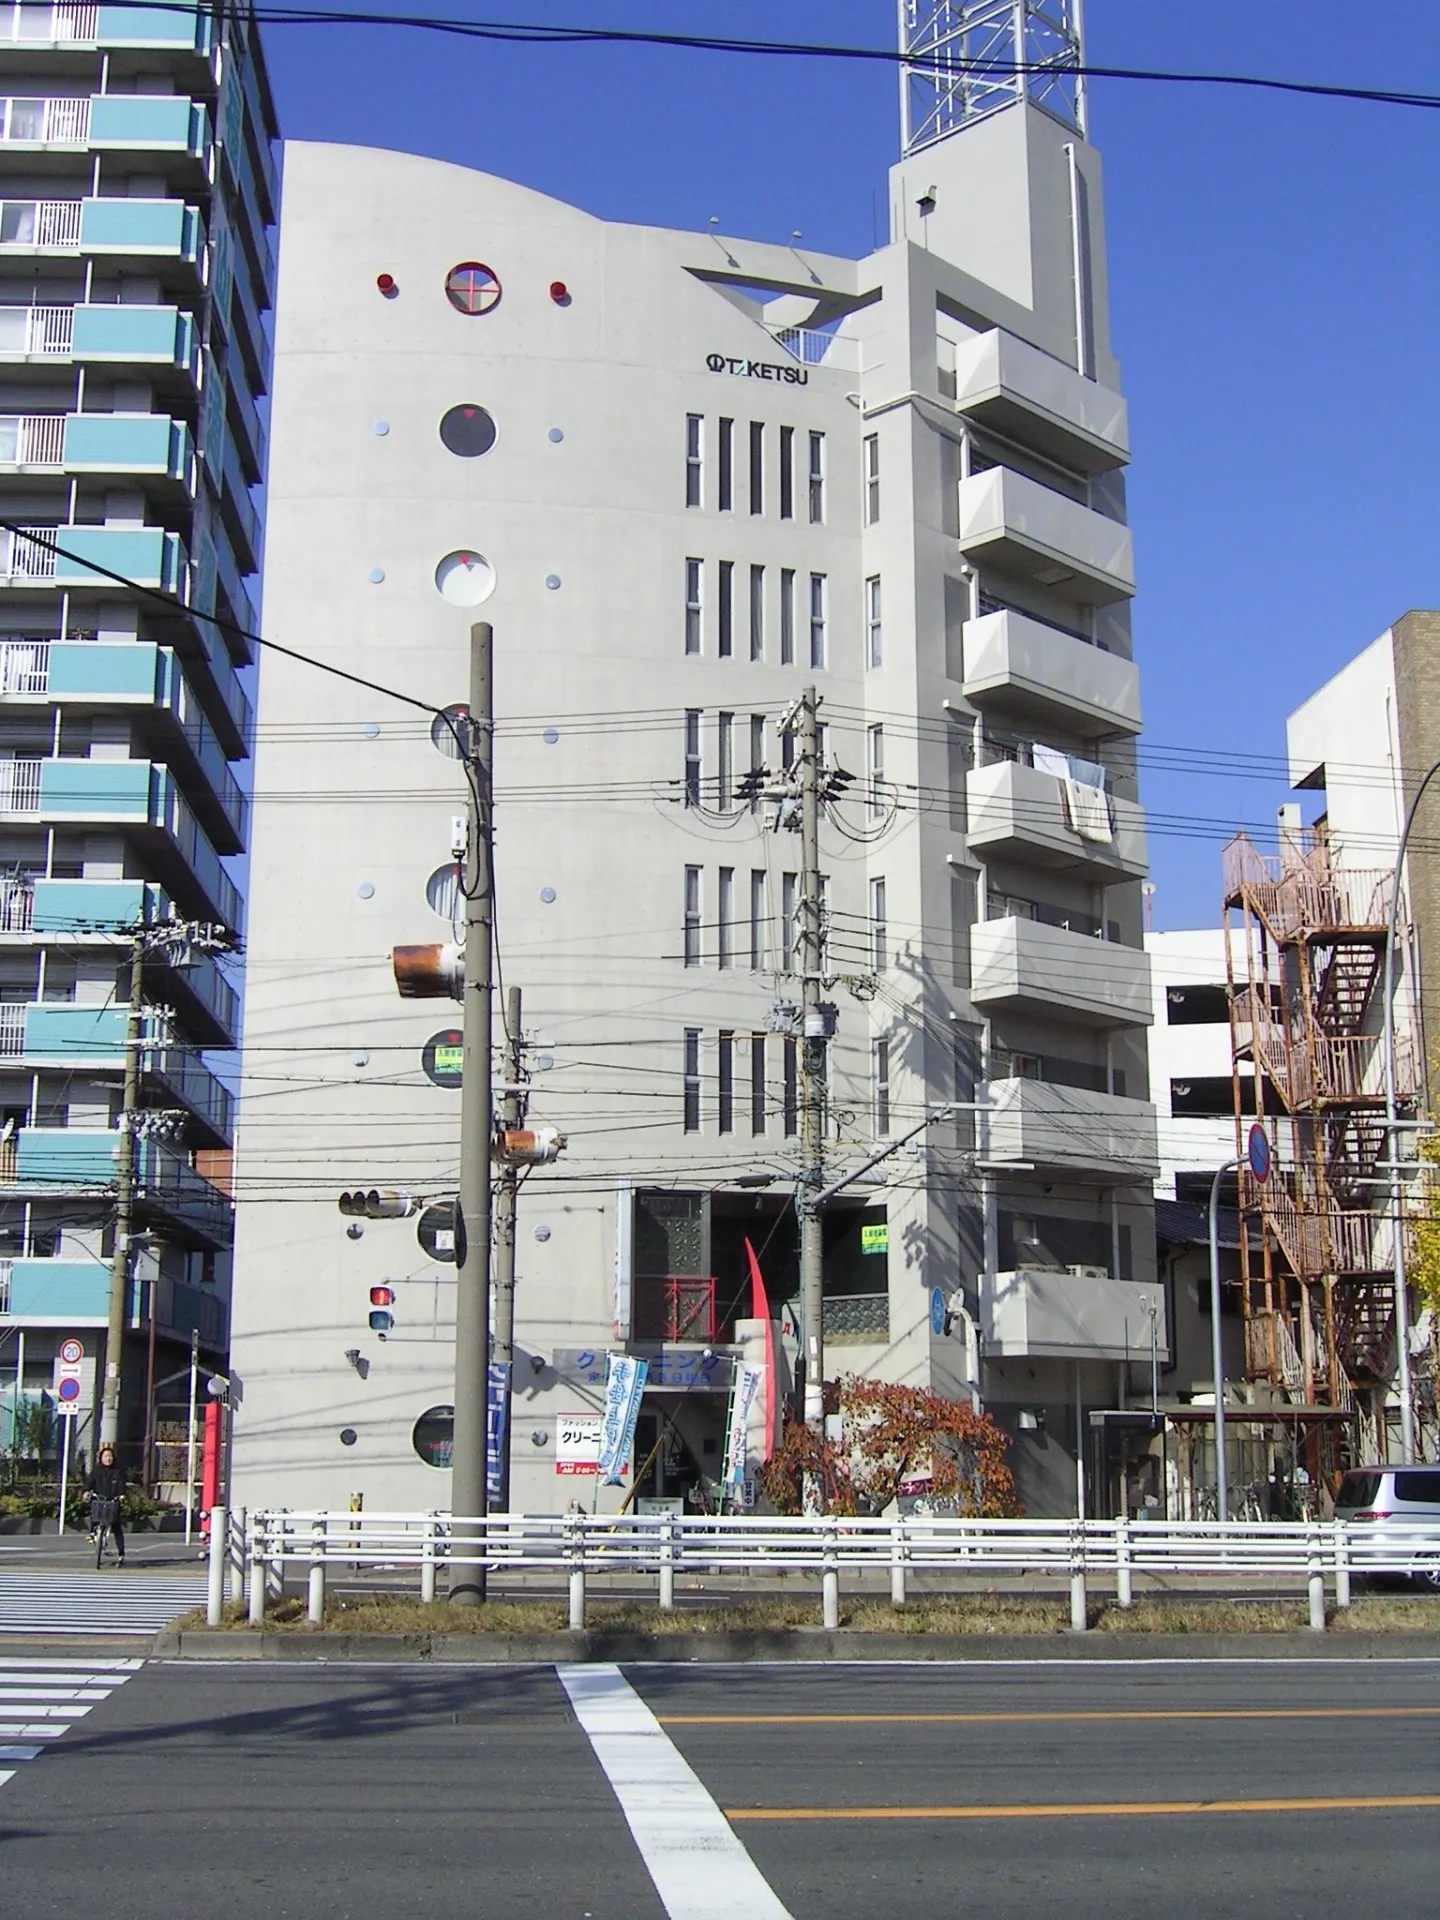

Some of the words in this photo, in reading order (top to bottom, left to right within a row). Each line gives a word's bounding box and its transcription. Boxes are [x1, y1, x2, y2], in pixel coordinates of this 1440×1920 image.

[66, 1346, 78, 1358] 20
[576, 1351, 719, 1370] クニング
